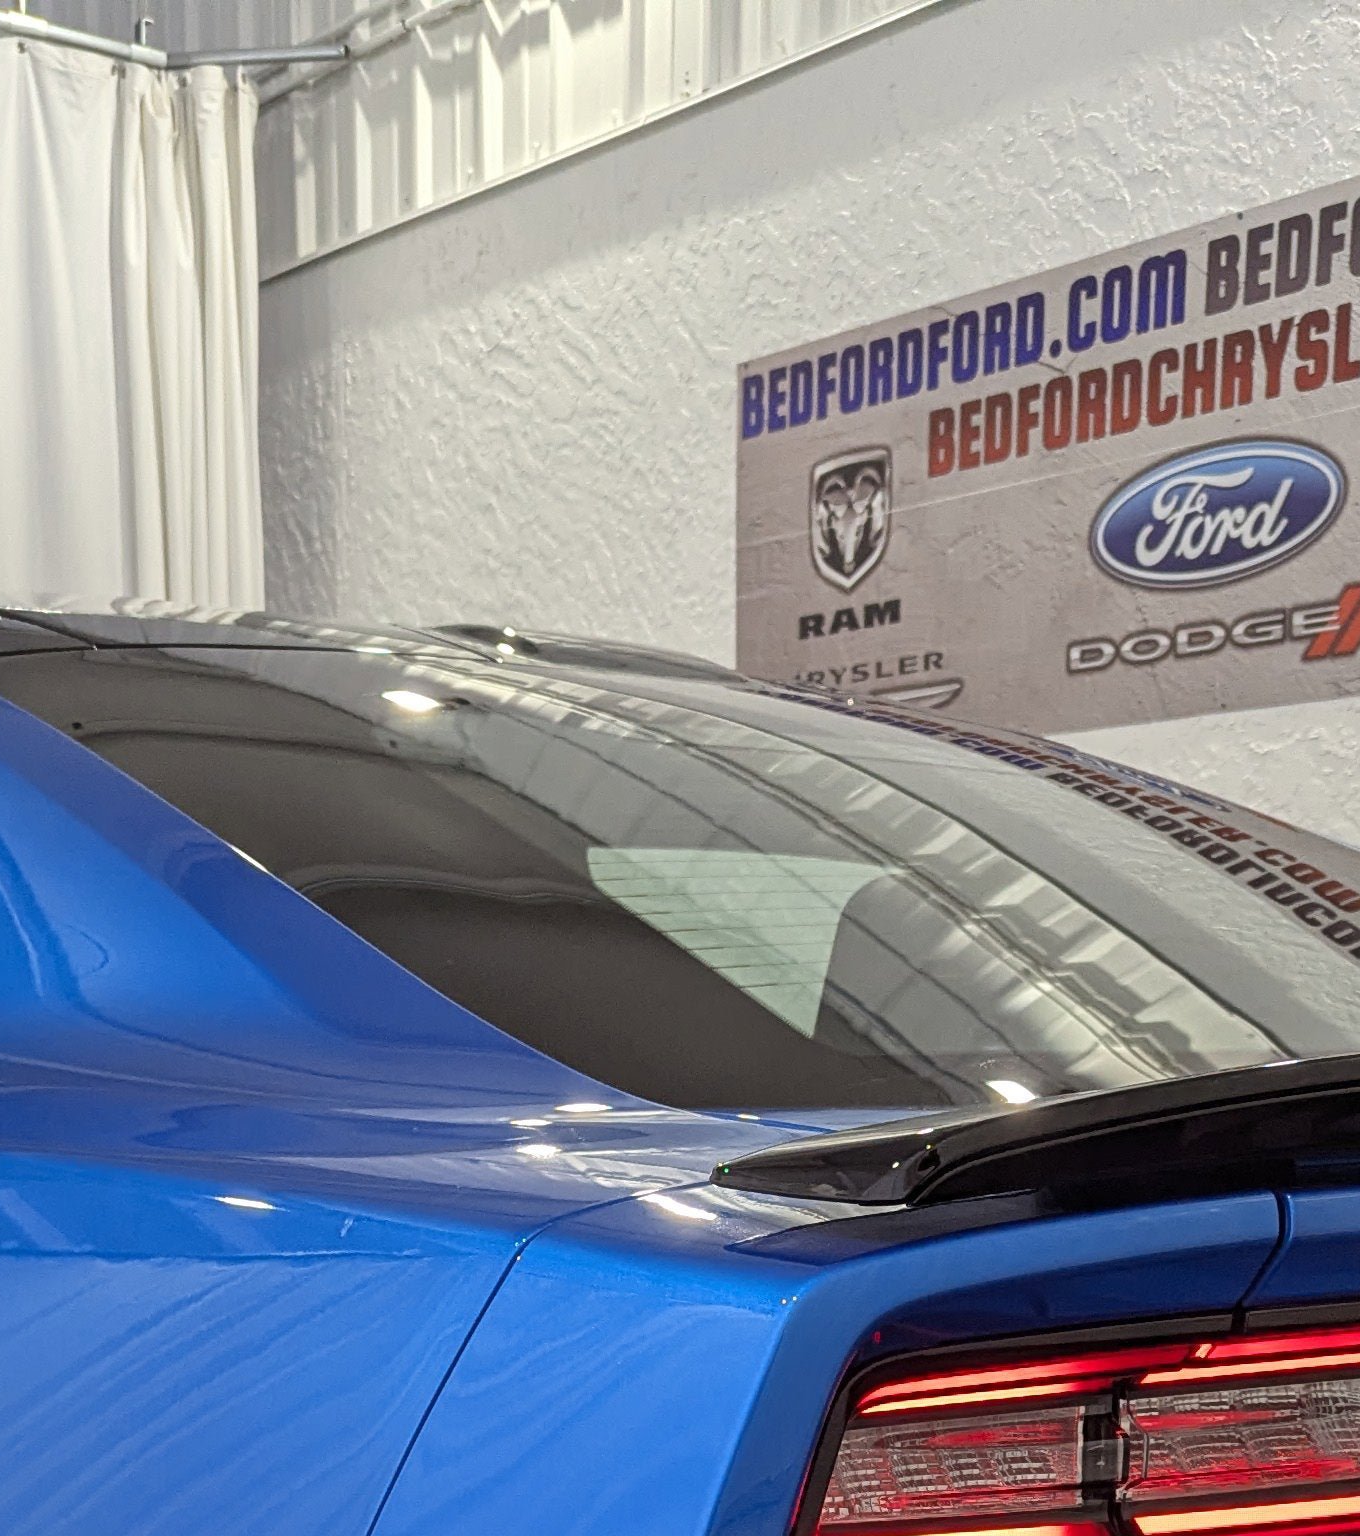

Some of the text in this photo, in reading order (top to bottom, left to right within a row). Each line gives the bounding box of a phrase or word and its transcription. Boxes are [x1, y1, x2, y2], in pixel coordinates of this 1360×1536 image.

[741, 249, 1188, 440] BEDFORDFORD.COM
[1135, 467, 1294, 567] Ford
[798, 599, 901, 640] RAM
[1066, 600, 1342, 673] DODGE
[795, 651, 944, 686] RYSLER
